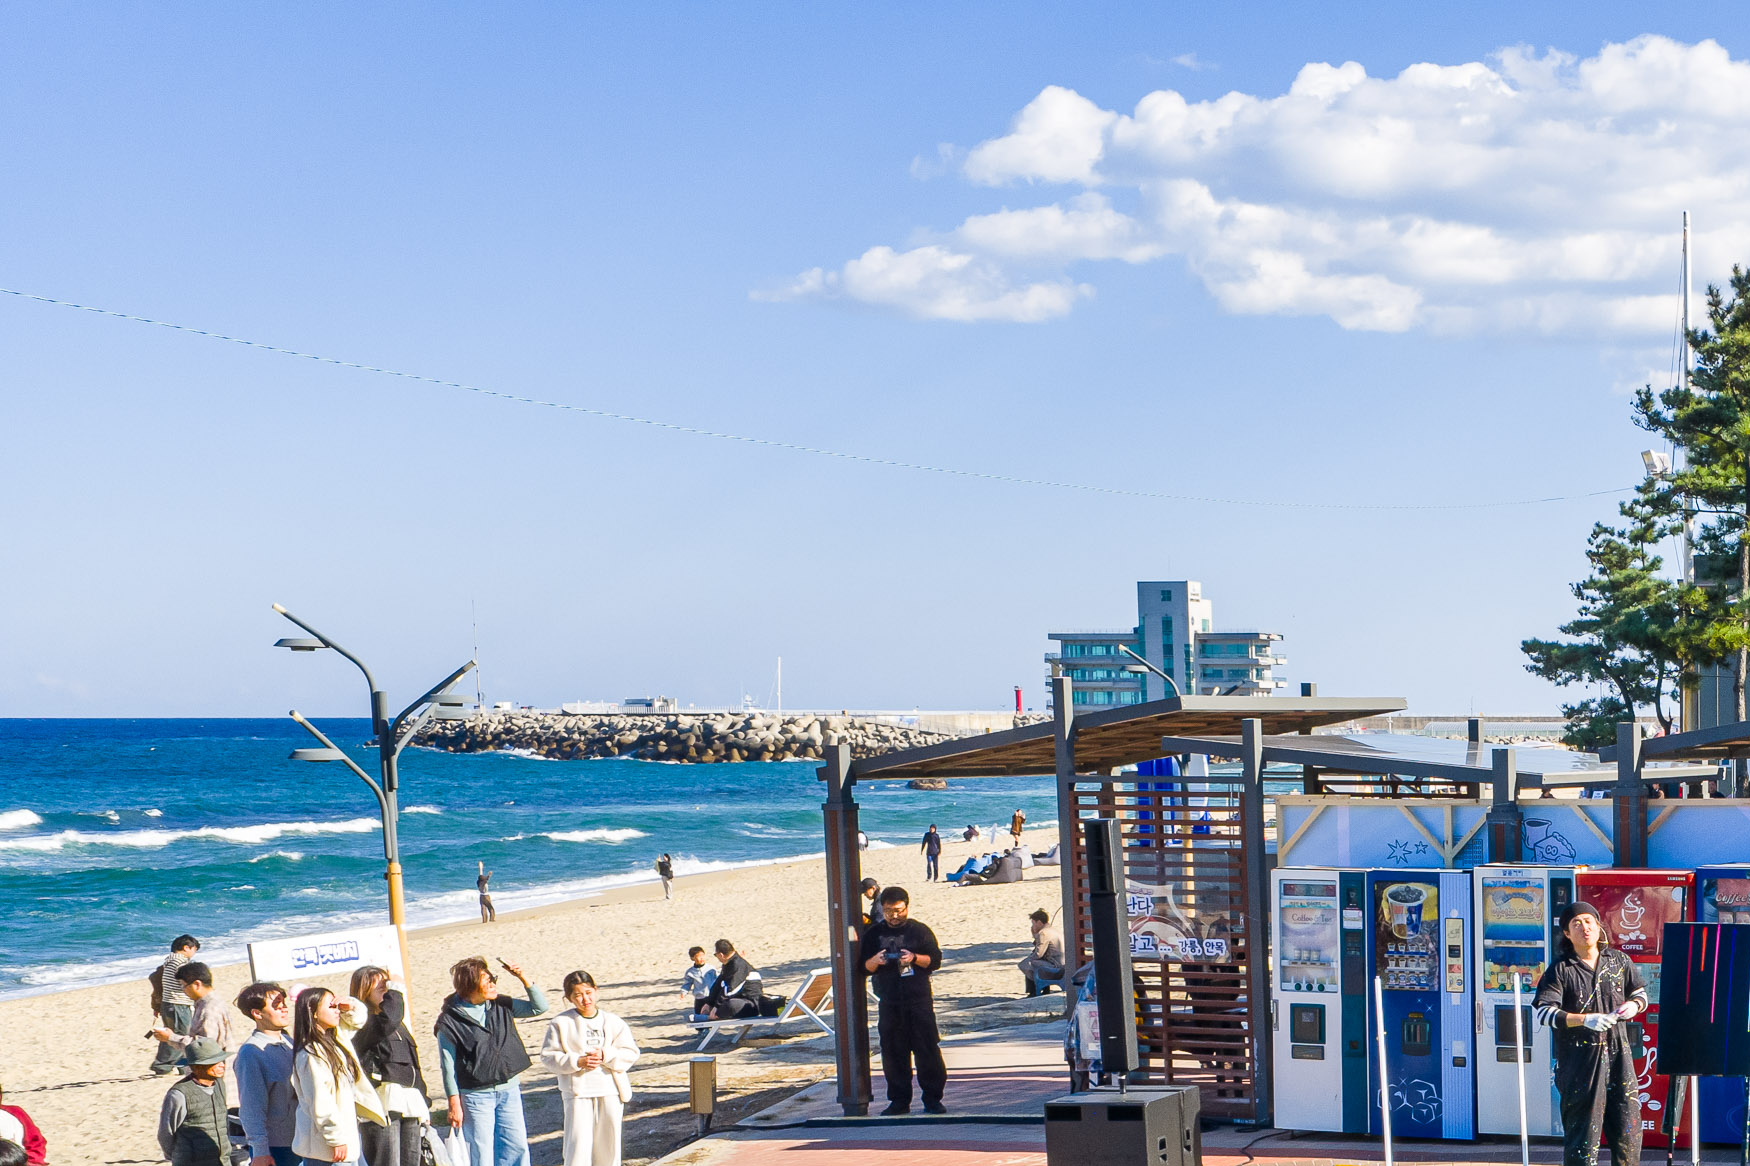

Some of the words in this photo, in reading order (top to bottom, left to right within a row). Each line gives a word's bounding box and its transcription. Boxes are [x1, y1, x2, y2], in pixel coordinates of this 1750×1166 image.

[1715, 892, 1747, 904] Coffee
[1204, 941, 1225, 954] 안목
[1621, 943, 1644, 951] COFFEE
